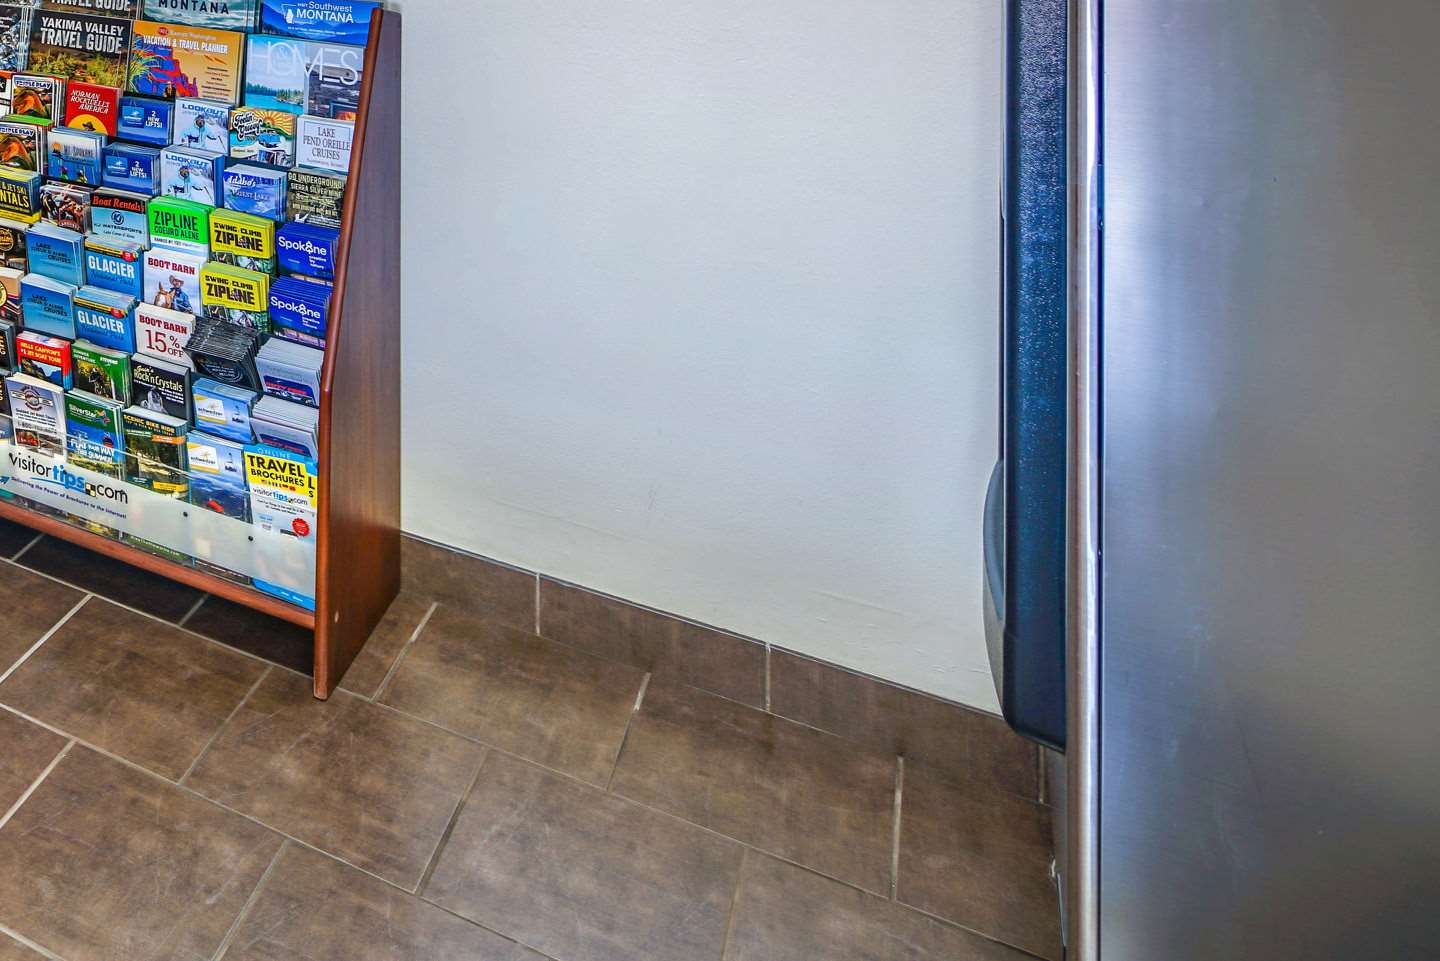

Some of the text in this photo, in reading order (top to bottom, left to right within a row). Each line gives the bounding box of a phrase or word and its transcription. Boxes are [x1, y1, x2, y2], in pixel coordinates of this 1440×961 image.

[41, 16, 124, 36] YAKIMA VALLEY
[296, 10, 354, 23] MONTANA
[41, 27, 123, 54] TRAVEL GUIDE
[143, 35, 228, 54] VACATION & TRAVEL PLANNER
[70, 90, 100, 101] NORMAN
[78, 104, 109, 114] AMERICA
[182, 103, 226, 116] LOOKOUT
[317, 126, 336, 138] LAKE
[303, 135, 351, 151] PEND OREILLE
[165, 153, 209, 167] LOOKOUT
[312, 147, 340, 160] CRUISES
[6, 182, 16, 192] JET
[16, 185, 27, 194] SKI
[92, 195, 143, 212] Boat Rentals
[102, 224, 143, 234] WATERSPORTS
[153, 210, 198, 232] ZIPLINE
[214, 222, 262, 238] SWING CLIMB
[214, 229, 263, 252] ZIPLINE
[278, 236, 327, 256] Spokane
[88, 255, 135, 278] GLACIER
[147, 257, 196, 275] BOOT BARN
[206, 283, 255, 305] ZIPLINE
[270, 296, 321, 319] Spokane
[77, 310, 125, 334] GLACIER
[139, 314, 188, 334] BOOT BARN
[145, 329, 184, 358] 15 % OFF
[134, 368, 154, 383] Rock'n
[154, 374, 183, 392] Crystals
[124, 415, 175, 433] SCENIC BIKE RIDE
[257, 447, 292, 459] ONLINE
[247, 454, 304, 478] TRAVEL
[9, 452, 128, 505] visitortips.com
[251, 469, 305, 487] BROCHURES
[34, 484, 43, 492] the
[44, 486, 58, 497] Power
[66, 493, 88, 506] Brochures
[105, 505, 127, 520] Internet!
[253, 487, 308, 506] visitortips.com
